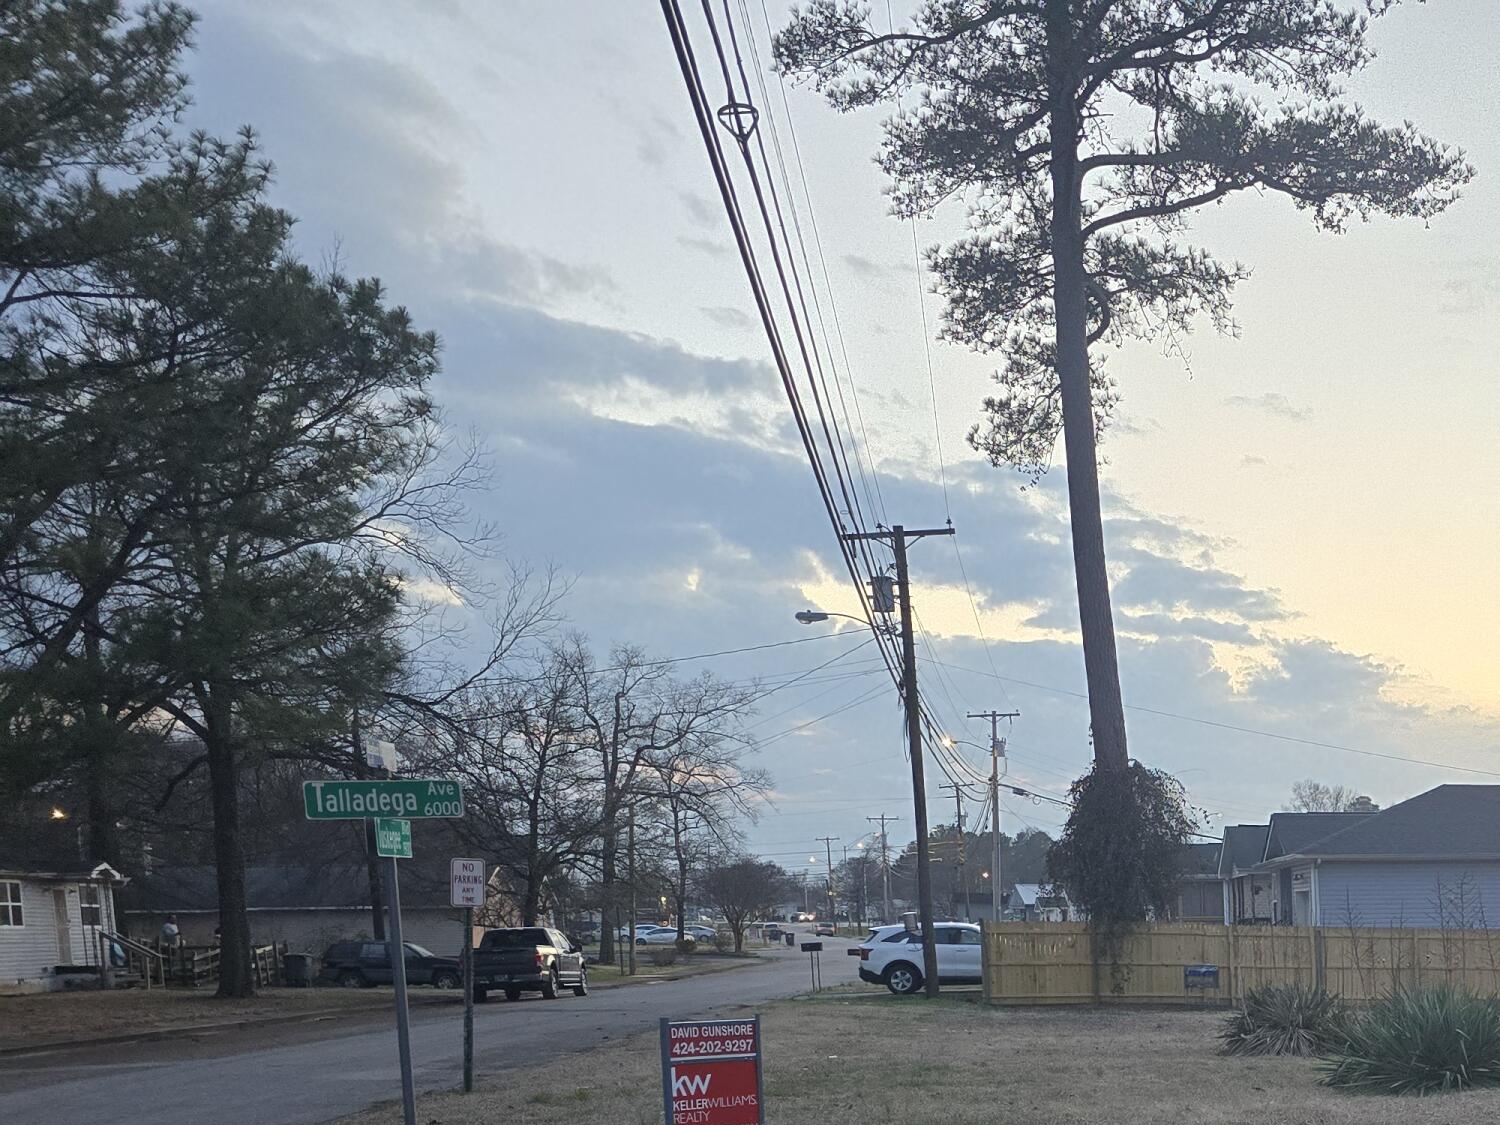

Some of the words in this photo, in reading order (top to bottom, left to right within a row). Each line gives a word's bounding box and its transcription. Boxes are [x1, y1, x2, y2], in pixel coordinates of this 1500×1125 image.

[312, 783, 418, 816] Talladega
[427, 782, 454, 796] Ave
[424, 801, 460, 816] 6000
[462, 863, 475, 872] NO
[454, 874, 482, 884] PARKING
[671, 1026, 699, 1039] DAVID
[701, 1024, 753, 1037] GUNSHORE
[673, 1039, 753, 1055] 424-202-9297
[671, 1067, 712, 1097] kw
[673, 1110, 711, 1124] REALTY
